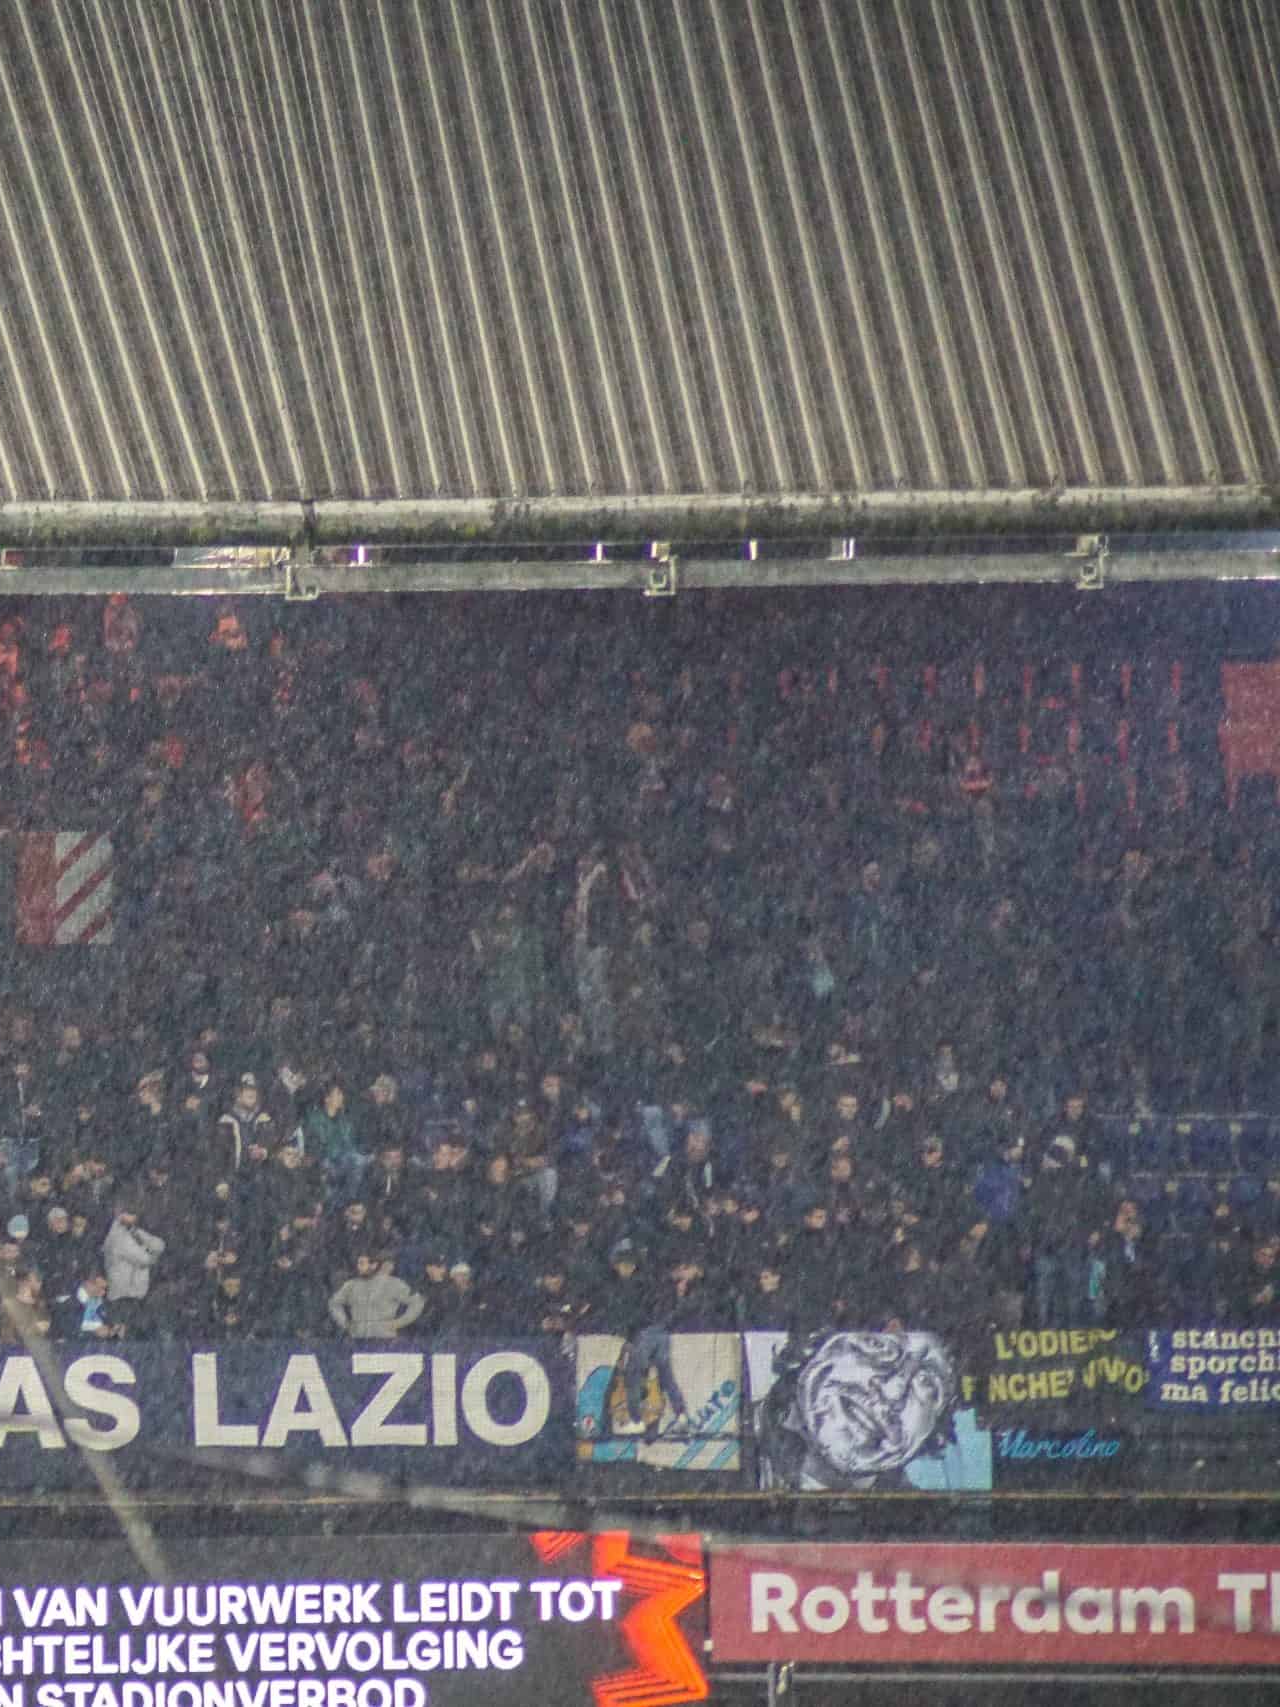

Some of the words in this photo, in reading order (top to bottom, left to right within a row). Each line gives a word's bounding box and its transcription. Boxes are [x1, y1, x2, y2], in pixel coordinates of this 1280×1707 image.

[1170, 1350, 1280, 1380] sporch
[192, 1351, 551, 1447] LAZIO
[1161, 1383, 1208, 1403] ma
[13, 1586, 108, 1629] VAN
[119, 1581, 382, 1627] VUURWERK
[393, 1580, 520, 1623] LEIDT
[529, 1580, 622, 1622] TOT
[749, 1570, 1197, 1634] Rotterdam
[224, 1629, 523, 1673] VERVOLGING
[36, 1677, 426, 1707] STADIONVERBOD
